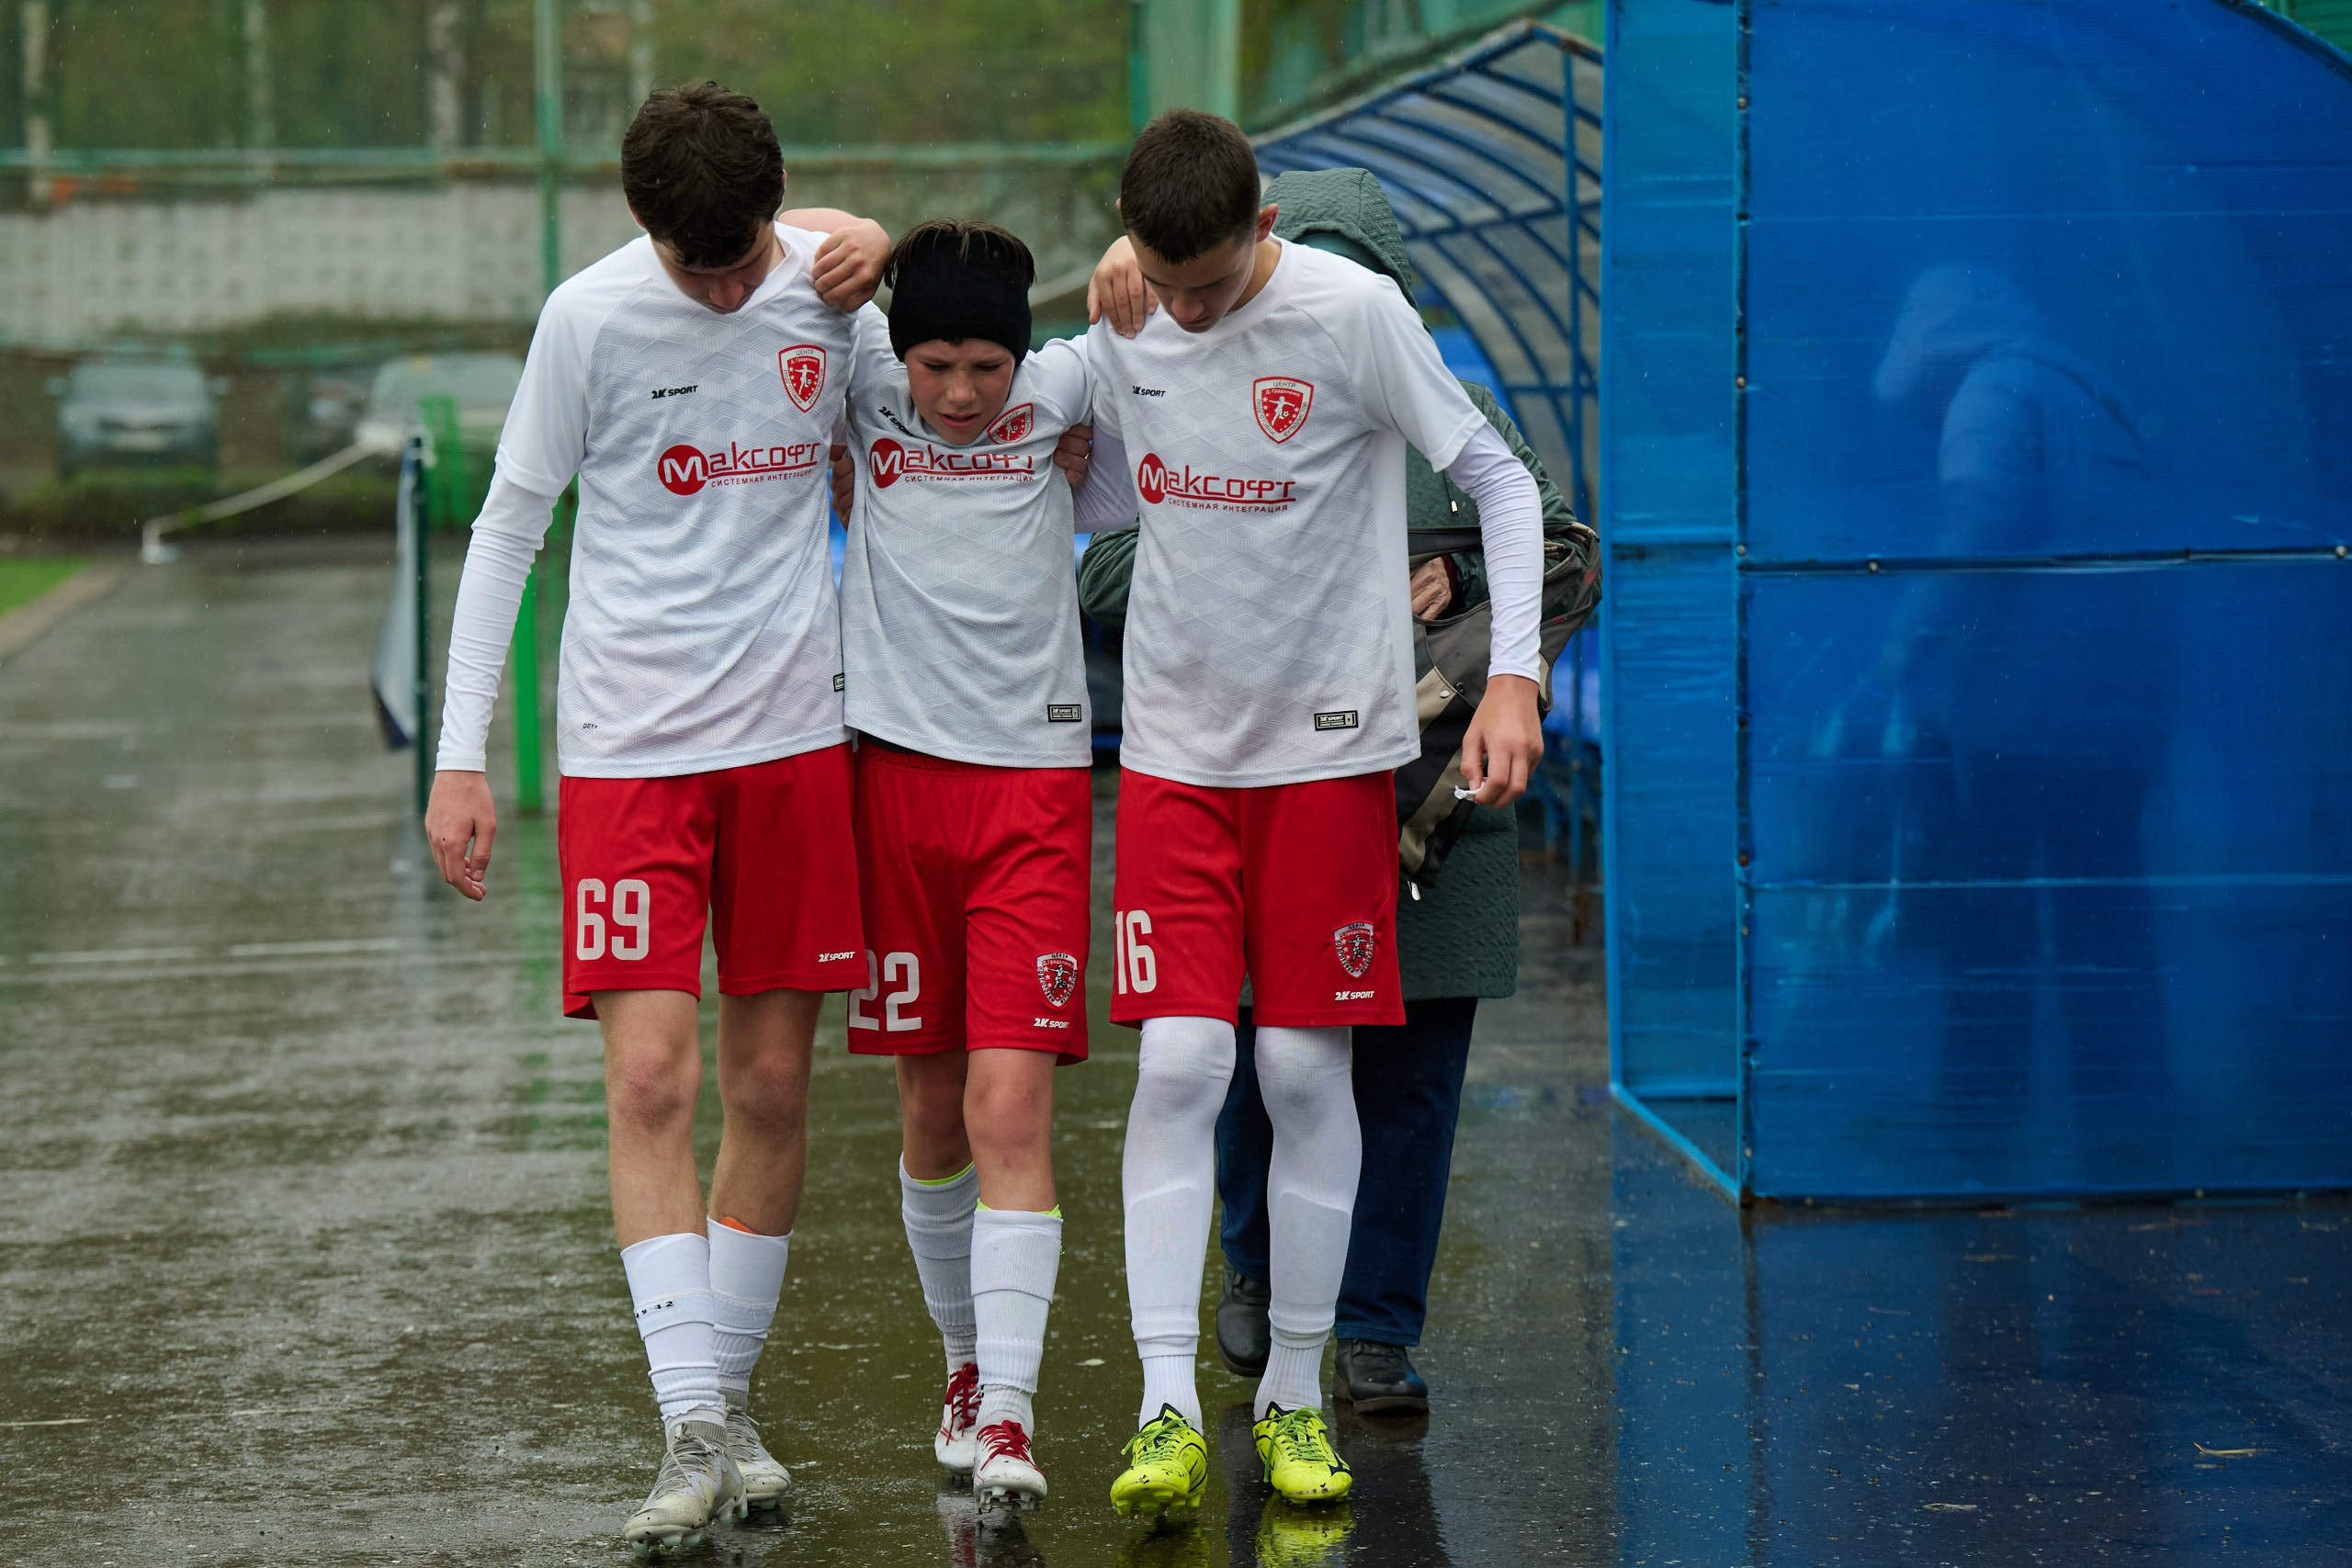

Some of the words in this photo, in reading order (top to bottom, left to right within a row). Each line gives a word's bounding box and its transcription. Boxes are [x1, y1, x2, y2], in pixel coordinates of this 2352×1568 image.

[1272, 380, 1296, 389] ЦЕНТР
[651, 388, 667, 399] 2K
[668, 385, 698, 397] SPORT
[1140, 389, 1167, 398] SPORT
[877, 406, 895, 418] 2K
[711, 476, 764, 488] СИСТЕМНАЯ
[767, 468, 812, 481] ИНТЕГРАЦИЯ
[904, 475, 965, 483] СИСТЕМНАЯ
[1168, 497, 1218, 510] СИСТЕМНАЯ
[1223, 504, 1288, 513] ИНТЕГРАЦИЯ
[576, 878, 650, 961] 69
[818, 953, 831, 963] 2K
[829, 951, 856, 962] SPORT
[1114, 909, 1157, 994] 16
[849, 949, 922, 1032] 22
[1334, 990, 1351, 1001] 2K
[1350, 990, 1375, 999] SPORT
[1033, 1017, 1049, 1028] 2K
[1048, 1020, 1070, 1029] SPORT
